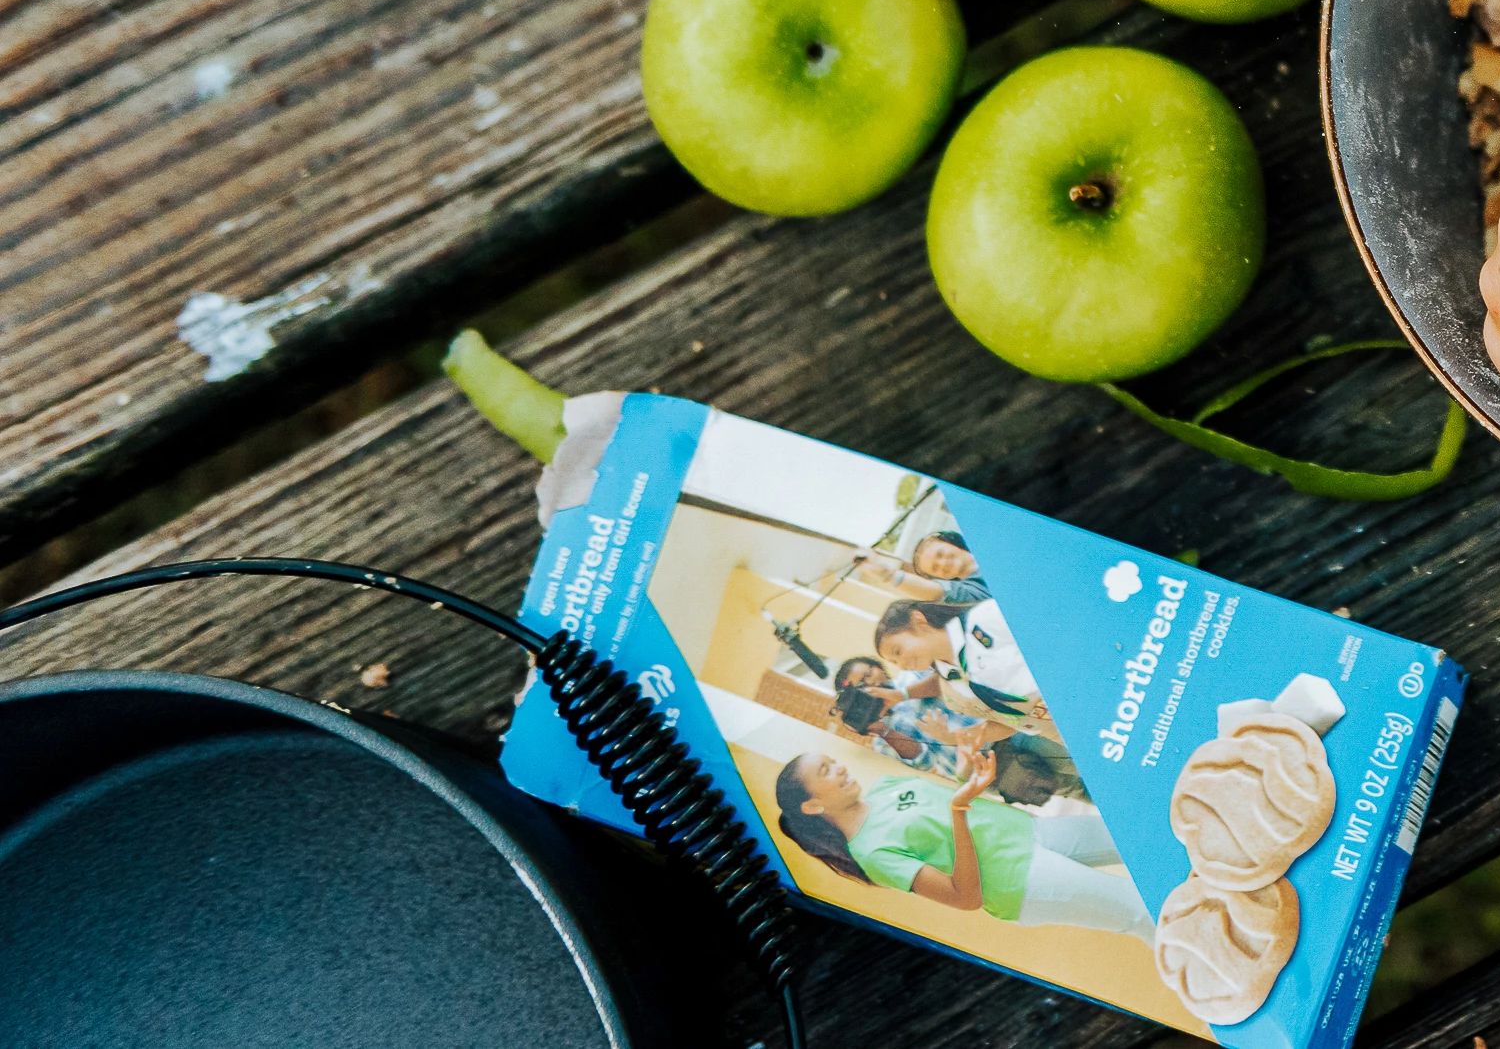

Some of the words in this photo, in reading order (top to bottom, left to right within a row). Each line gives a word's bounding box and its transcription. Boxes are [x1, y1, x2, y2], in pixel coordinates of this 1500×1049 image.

[622, 471, 649, 519] Scouts
[612, 517, 633, 547] Girl
[548, 547, 571, 581] here
[559, 514, 615, 643] ortbread
[599, 547, 623, 583] from
[539, 581, 560, 616] open
[591, 582, 612, 615] only
[1207, 595, 1241, 659] cookies.
[1099, 575, 1189, 763] shortbread
[1340, 637, 1363, 683] SUGGESTION
[1141, 678, 1188, 768] Traditional
[1177, 590, 1221, 679] shortbread
[1369, 711, 1414, 770] (255g)
[1361, 769, 1389, 798] OZ
[1354, 798, 1378, 815] 9
[1343, 812, 1372, 844] WT
[1330, 843, 1361, 881] NET
